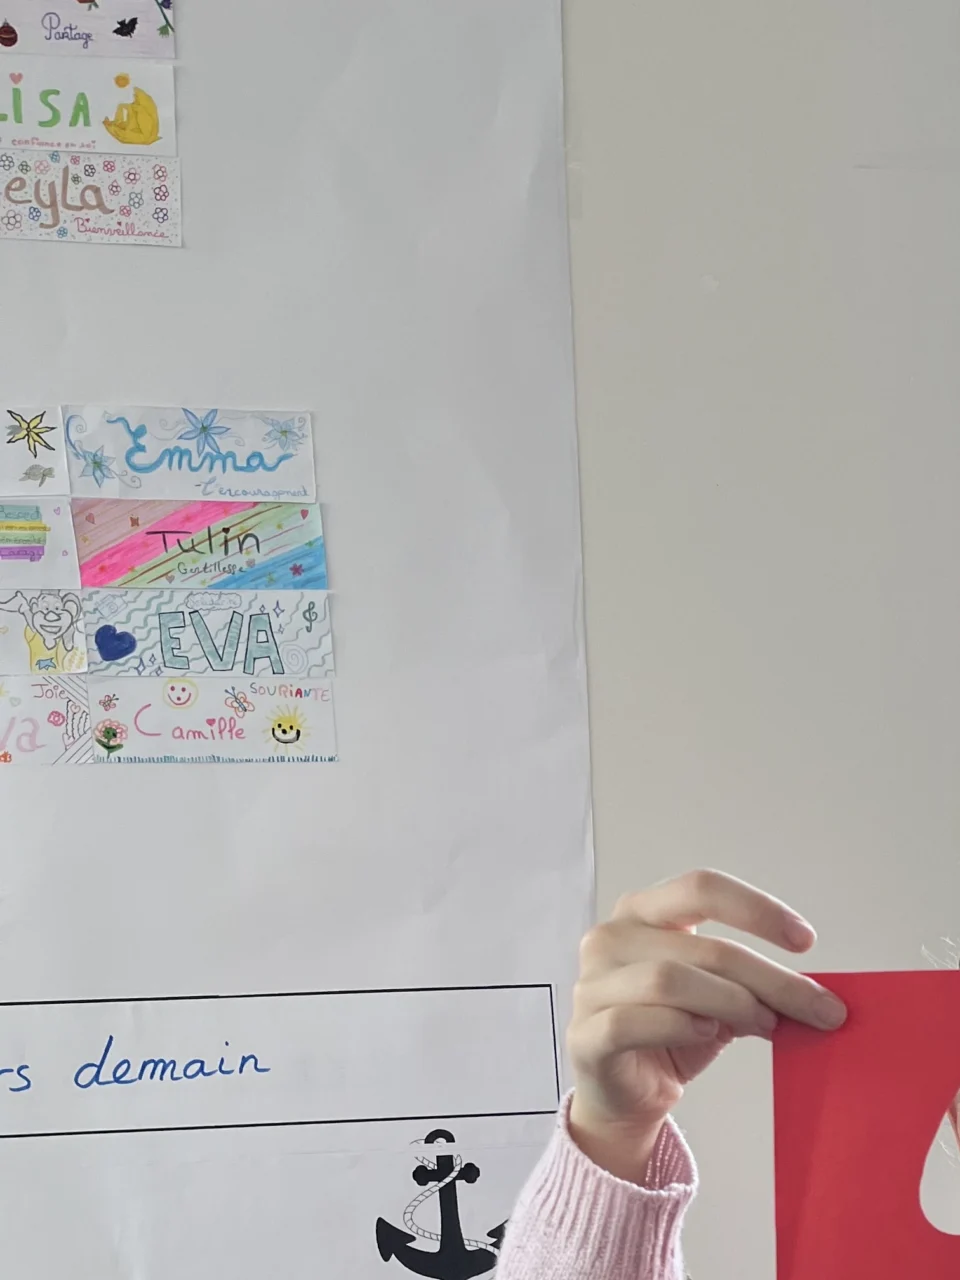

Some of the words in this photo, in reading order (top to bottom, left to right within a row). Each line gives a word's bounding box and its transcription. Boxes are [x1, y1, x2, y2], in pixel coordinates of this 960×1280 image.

[42, 12, 94, 49] Partage
[74, 217, 170, 239] Bienveillance
[104, 415, 298, 475] Emma
[146, 525, 261, 555] Tulin
[158, 610, 285, 676] EVA
[31, 683, 69, 700] Joie
[134, 704, 248, 742] Camille
[74, 1035, 271, 1090] demain
